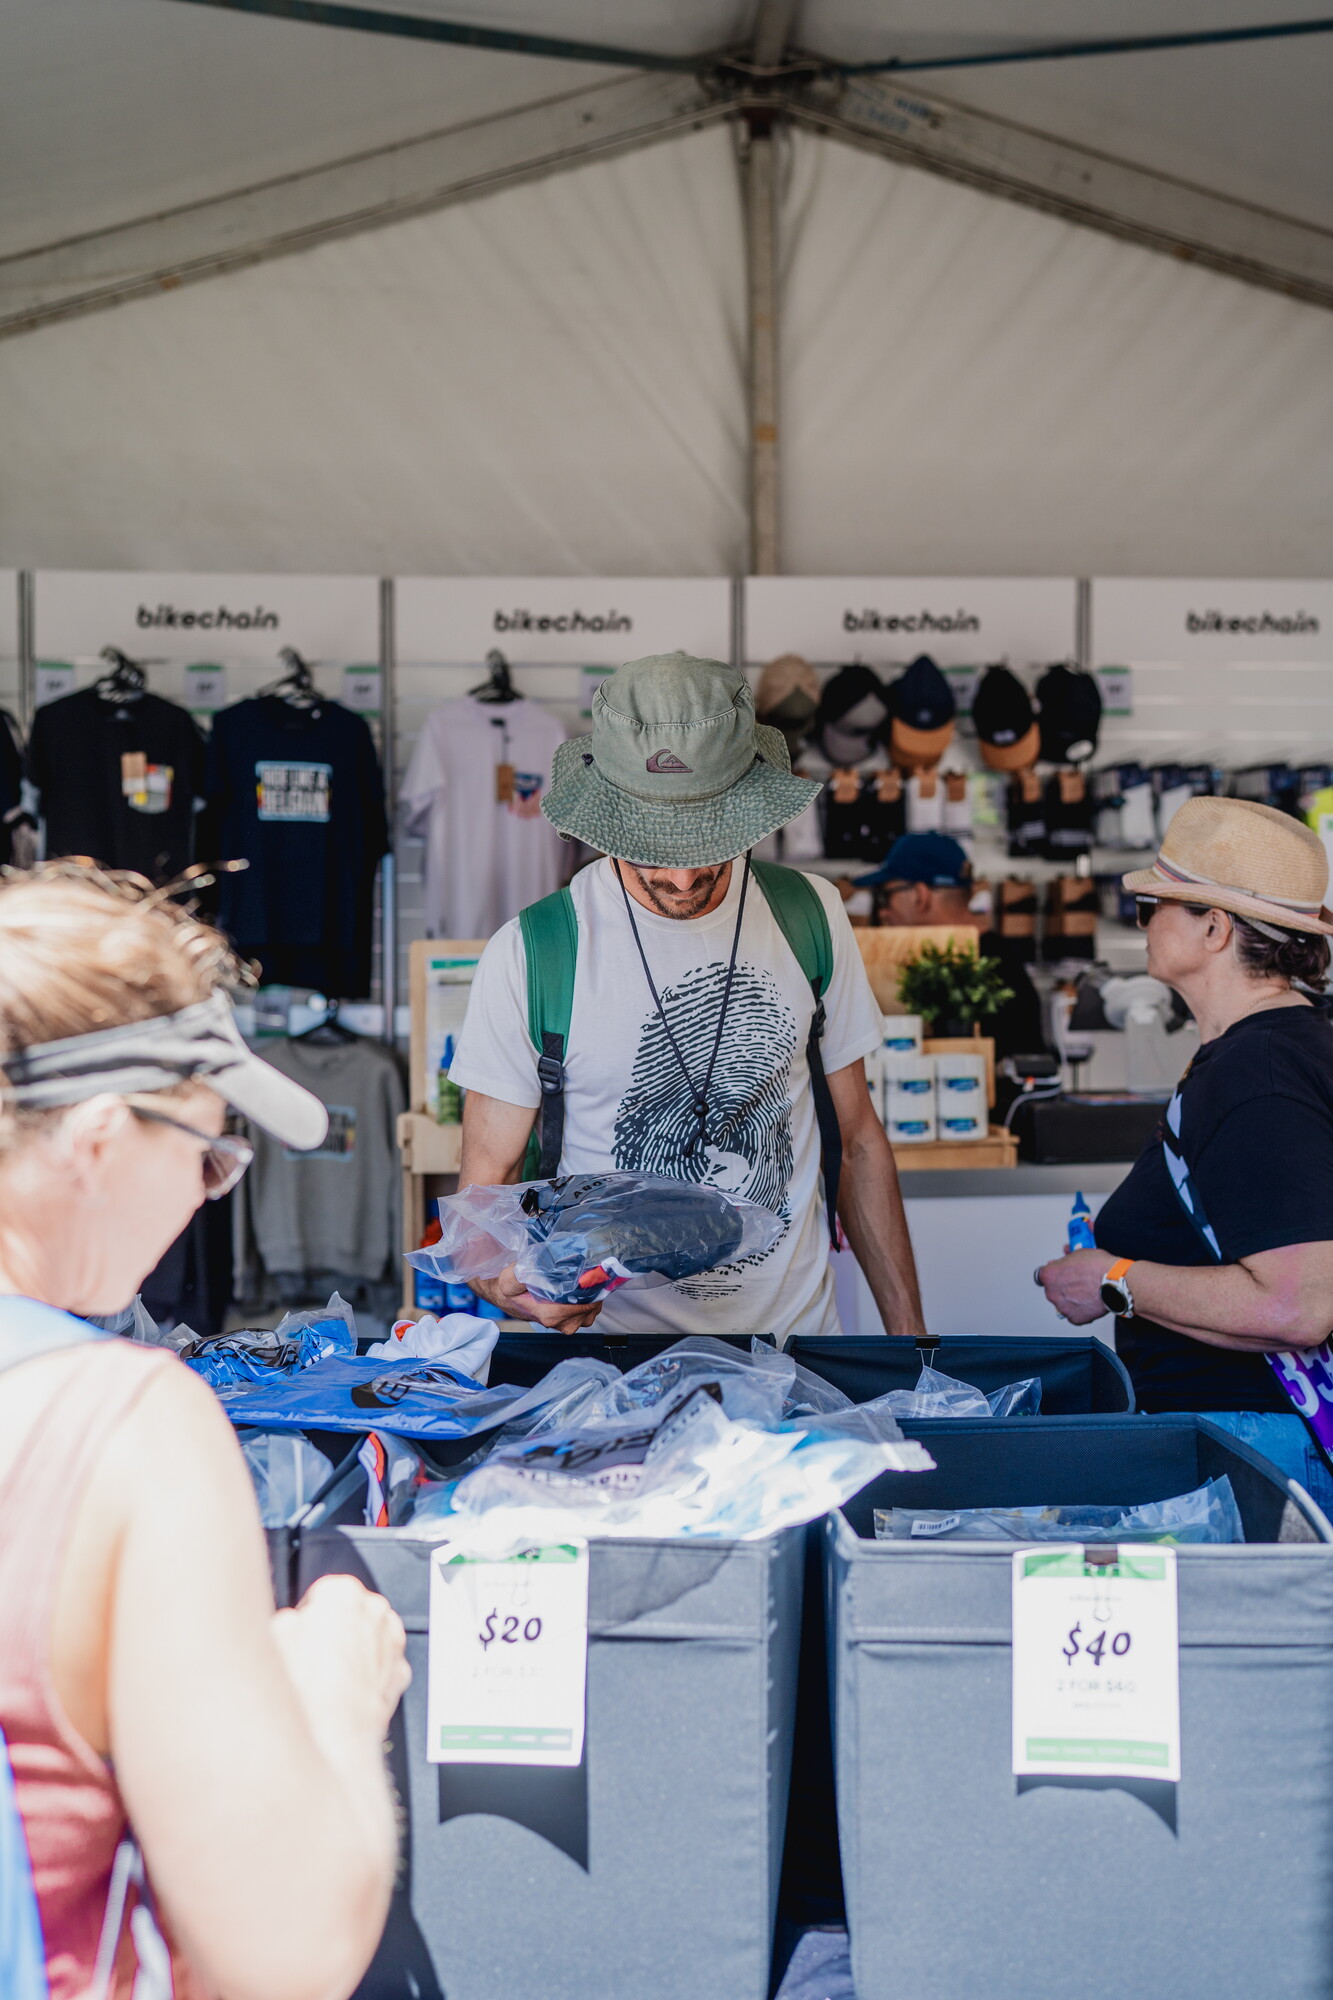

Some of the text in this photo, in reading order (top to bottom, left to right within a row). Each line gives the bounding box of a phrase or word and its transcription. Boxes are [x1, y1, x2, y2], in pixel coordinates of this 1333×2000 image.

[137, 604, 278, 629] bikechain
[494, 608, 632, 632] bikechain
[843, 607, 980, 633] bikechain
[1186, 608, 1320, 634] bikechain
[478, 1606, 542, 1652] $20
[1061, 1620, 1131, 1666] $40
